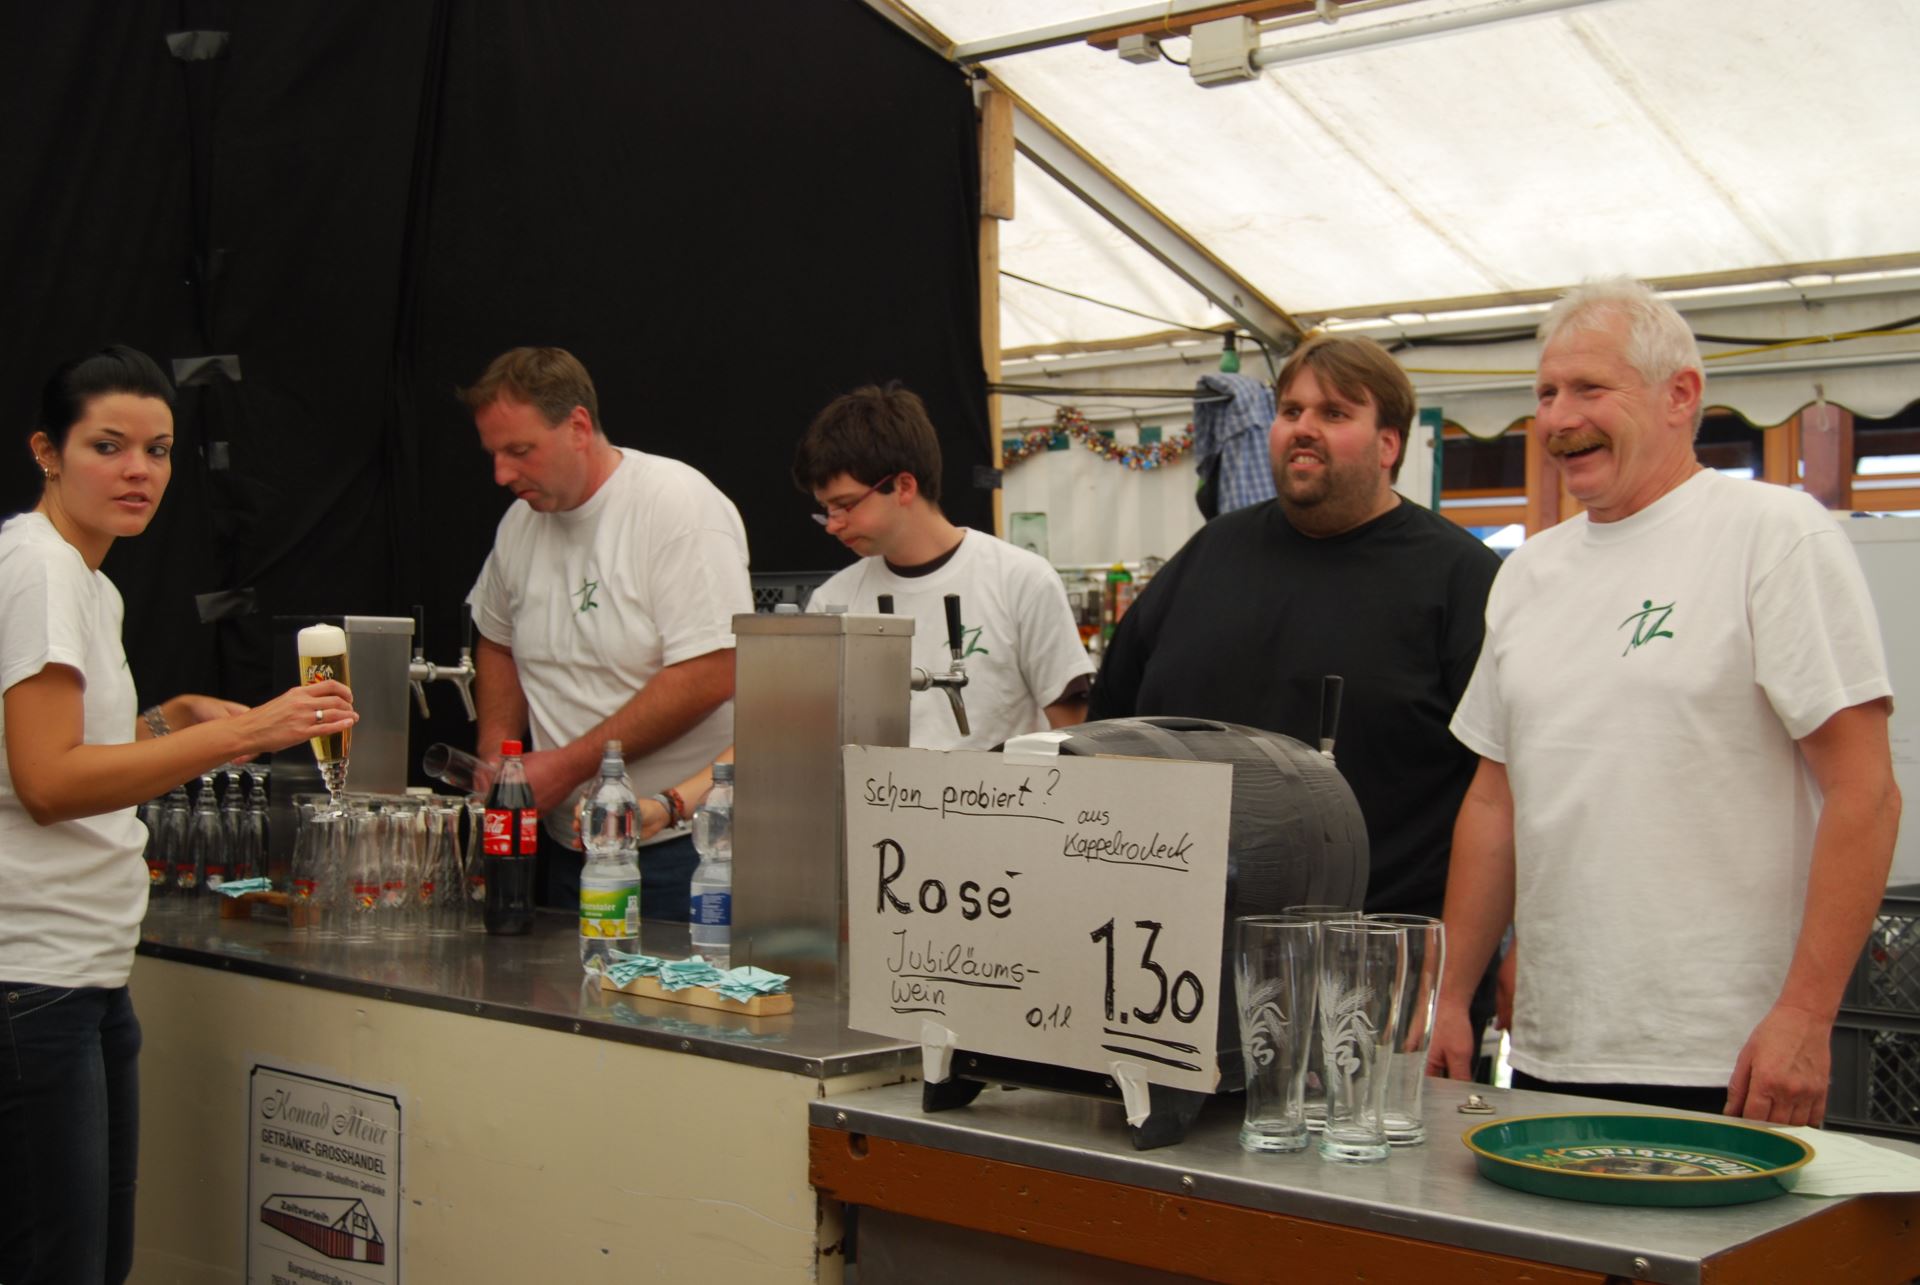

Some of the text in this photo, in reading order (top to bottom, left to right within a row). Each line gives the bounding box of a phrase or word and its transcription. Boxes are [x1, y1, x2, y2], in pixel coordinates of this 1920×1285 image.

[1077, 809, 1110, 826] aus
[1063, 830, 1194, 865] Kappelrodeck
[872, 837, 1023, 921] Rosé
[887, 929, 1040, 983] Jubiläums-
[1090, 917, 1204, 1024] 1.30
[262, 1128, 386, 1175] GETRÄNKE-GROSSHANDEL
[280, 1200, 329, 1222] Zeltverleih
